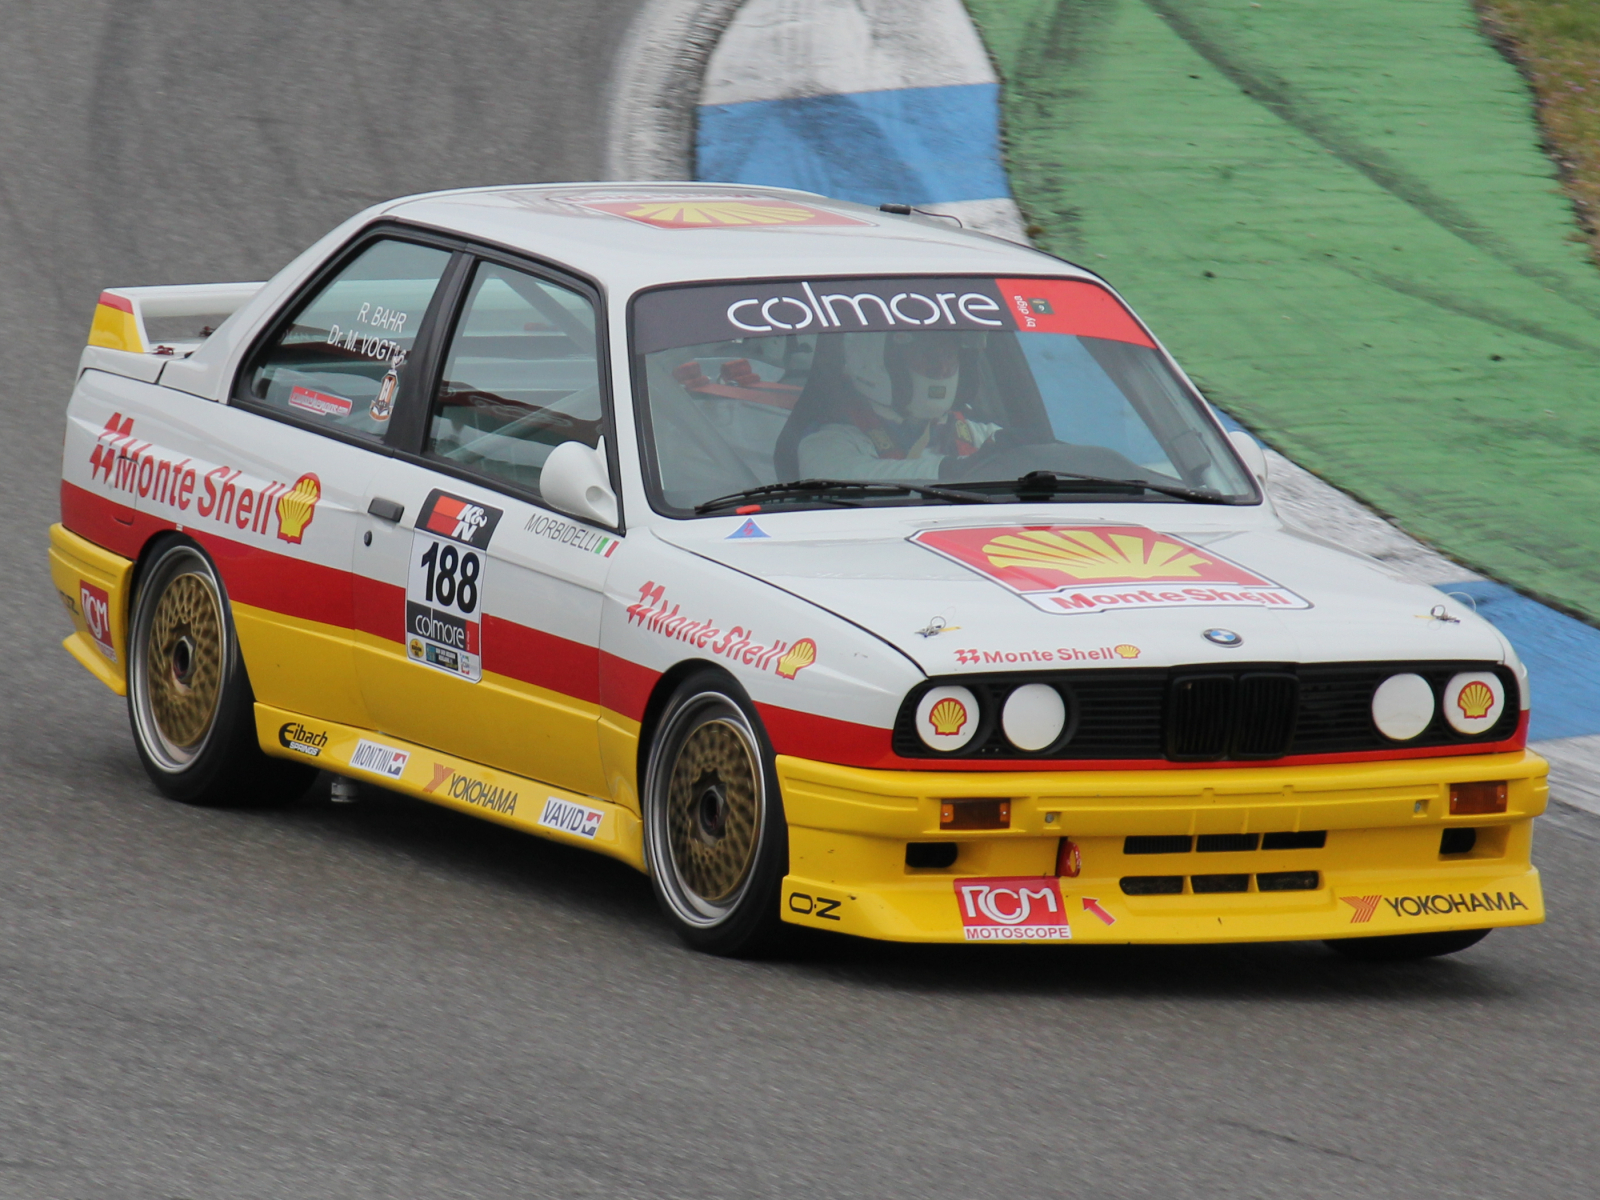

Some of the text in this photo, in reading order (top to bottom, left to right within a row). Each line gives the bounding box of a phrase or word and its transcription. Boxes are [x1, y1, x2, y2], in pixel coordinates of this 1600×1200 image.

[357, 302, 407, 333] R. BAHR
[727, 281, 1003, 332] colmore
[327, 325, 396, 362] Dr. M. VOGT
[114, 437, 286, 535] Monte Shell
[524, 513, 602, 552] MORBIDELLI
[421, 541, 480, 614] 188
[415, 607, 465, 649] colmore
[647, 600, 787, 671] Monte Shell
[984, 646, 1114, 664] Monte Shell
[278, 722, 328, 748] Eibach
[289, 741, 319, 756] SPRINGS
[352, 743, 393, 772] MONTINI
[447, 772, 519, 816] YOKOHAMA
[541, 800, 585, 831] VAVID
[1384, 891, 1529, 917] YOKOHAMA
[966, 926, 1070, 940] MOTOSCOPE
